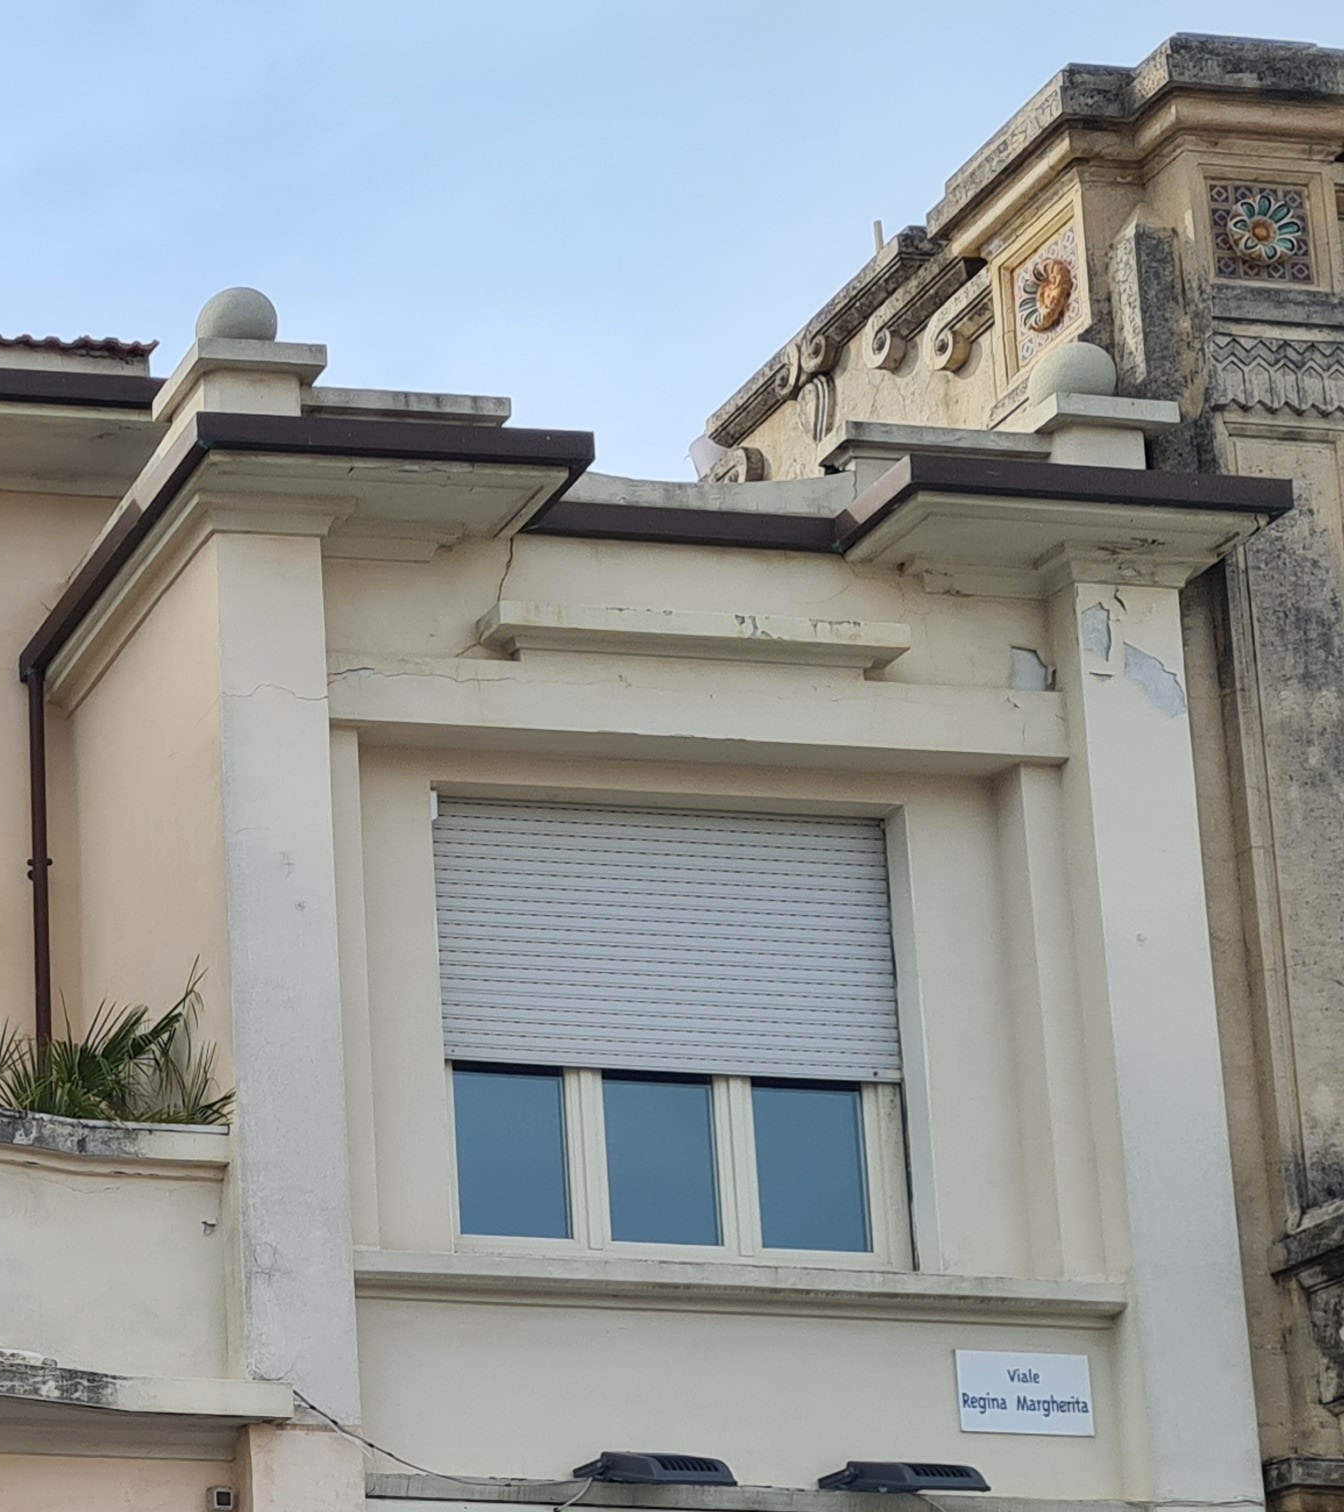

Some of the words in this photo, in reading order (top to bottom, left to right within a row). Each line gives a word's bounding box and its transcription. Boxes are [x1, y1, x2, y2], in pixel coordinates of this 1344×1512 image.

[1007, 1368, 1040, 1384] Viale
[962, 1392, 1008, 1414] Regina
[1016, 1395, 1090, 1417] Margherita
